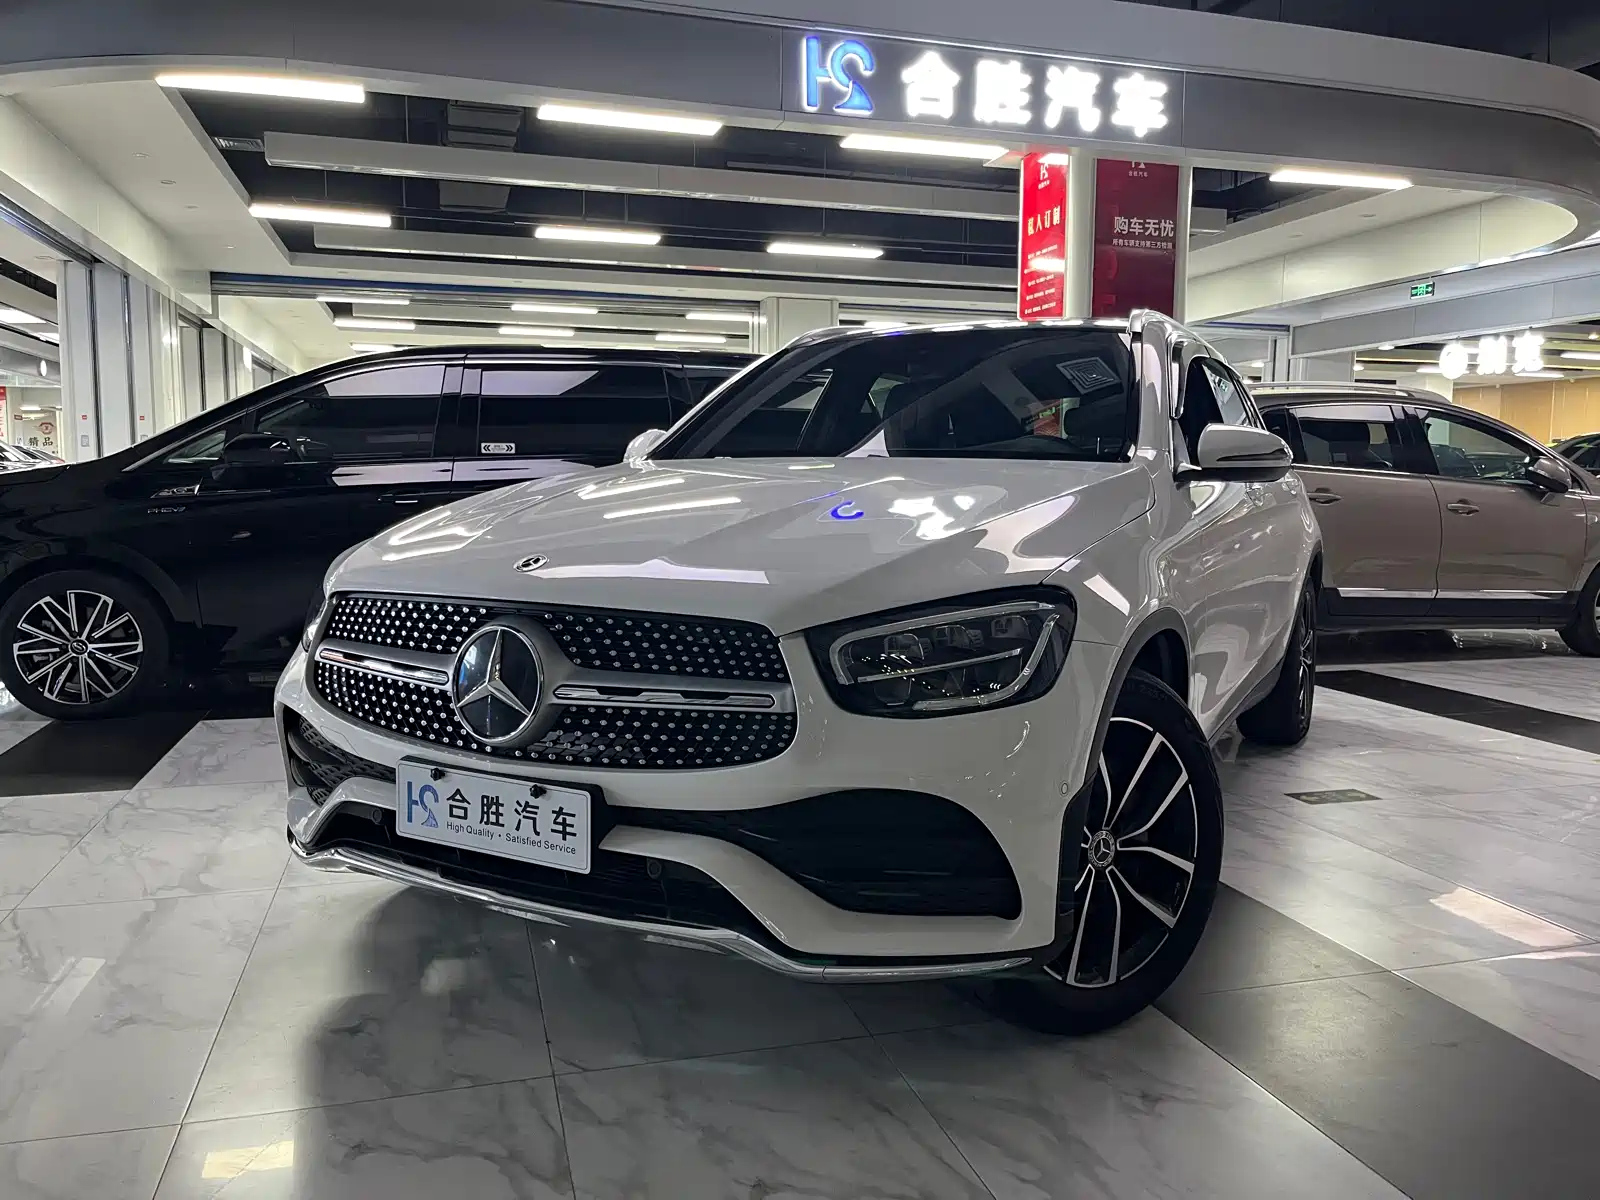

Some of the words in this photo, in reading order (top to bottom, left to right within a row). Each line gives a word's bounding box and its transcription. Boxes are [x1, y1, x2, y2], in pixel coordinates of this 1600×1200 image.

[901, 50, 1168, 138] 合胜汽车
[1113, 216, 1175, 237] 购车无忧
[446, 787, 577, 842] 合胜汽车
[446, 821, 465, 834] High
[466, 824, 495, 840] Quality
[505, 833, 542, 848] Satisfied
[544, 840, 576, 855] Service
